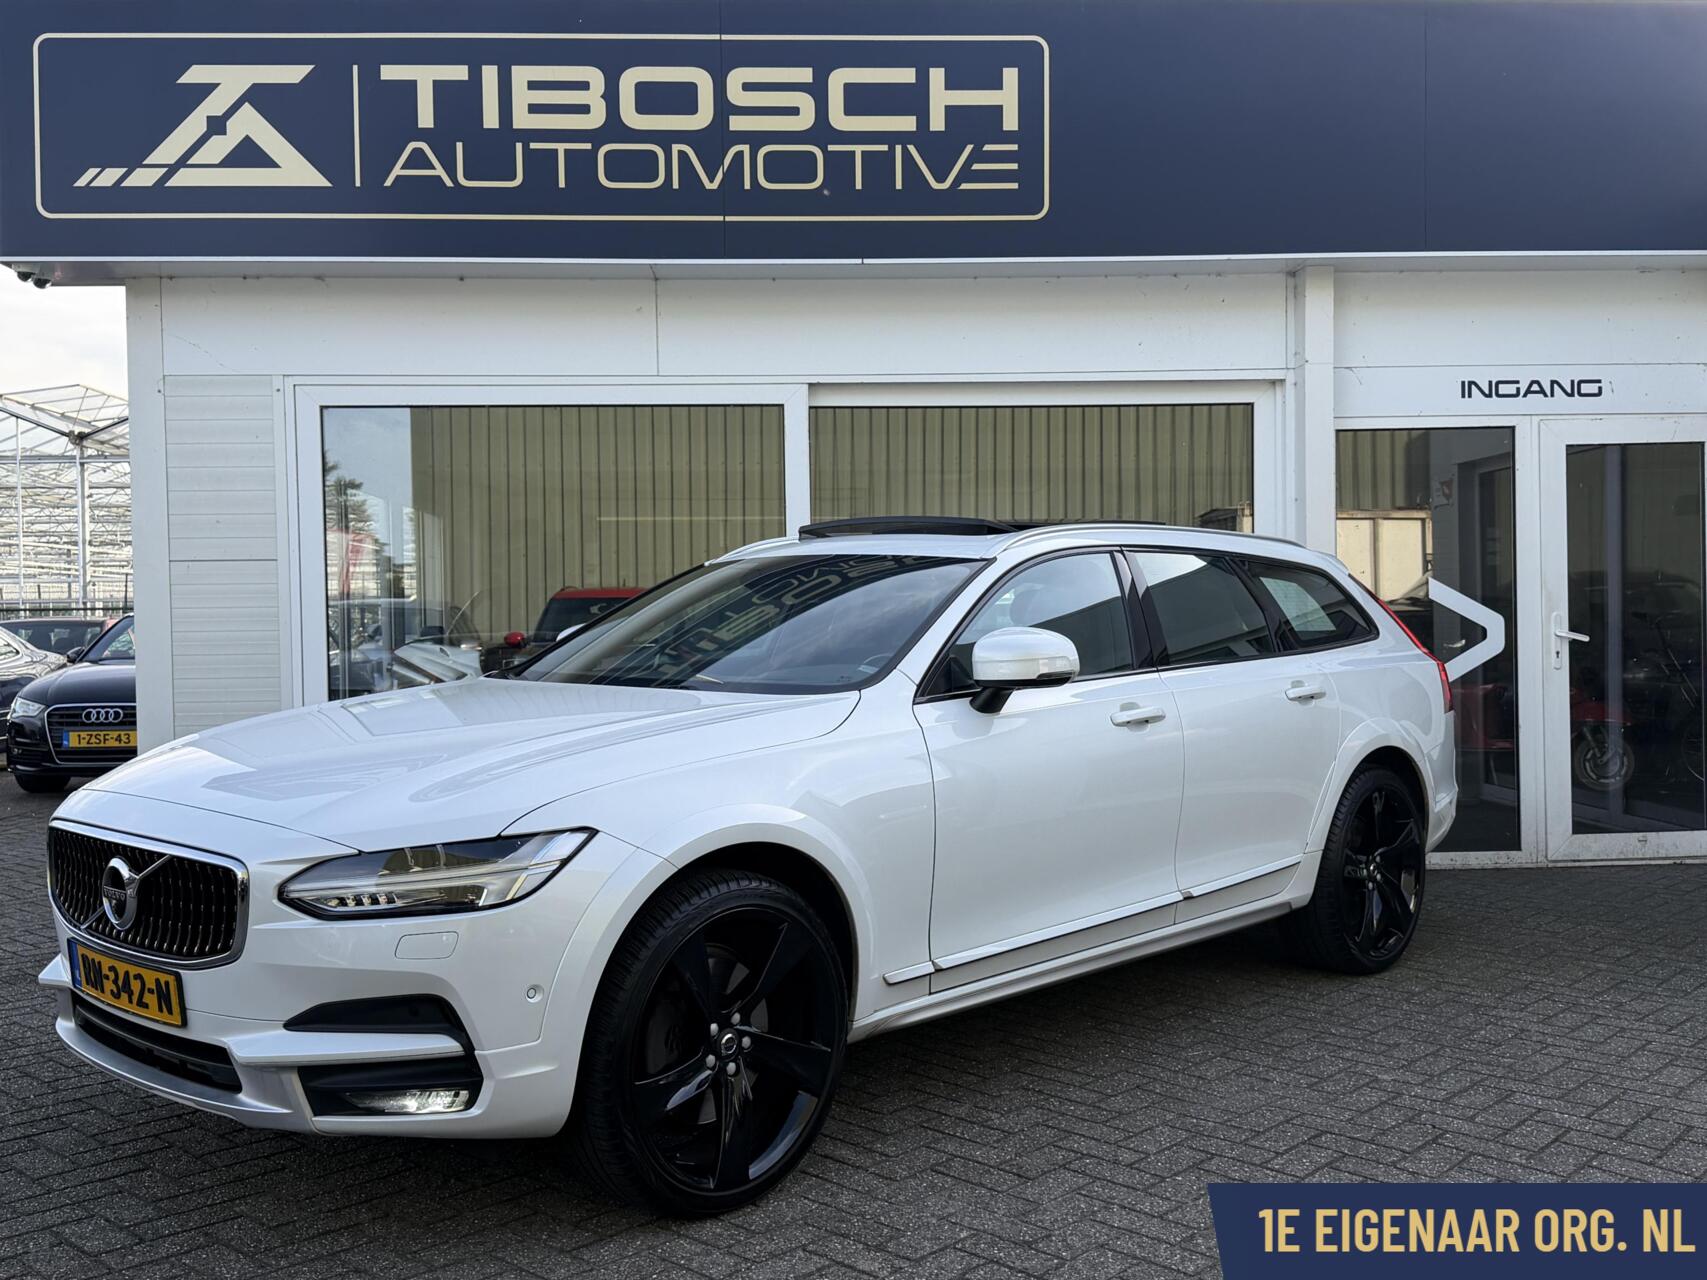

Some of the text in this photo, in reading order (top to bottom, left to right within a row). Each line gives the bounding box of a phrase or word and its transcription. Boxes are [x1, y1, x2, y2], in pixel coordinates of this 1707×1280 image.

[380, 64, 1019, 132] TIBOSCH
[383, 141, 1019, 190] AUTOMOTIVE
[1460, 379, 1603, 399] INGANG
[77, 733, 131, 745] 1-ZSF-43
[81, 953, 173, 1016] RN-342-N
